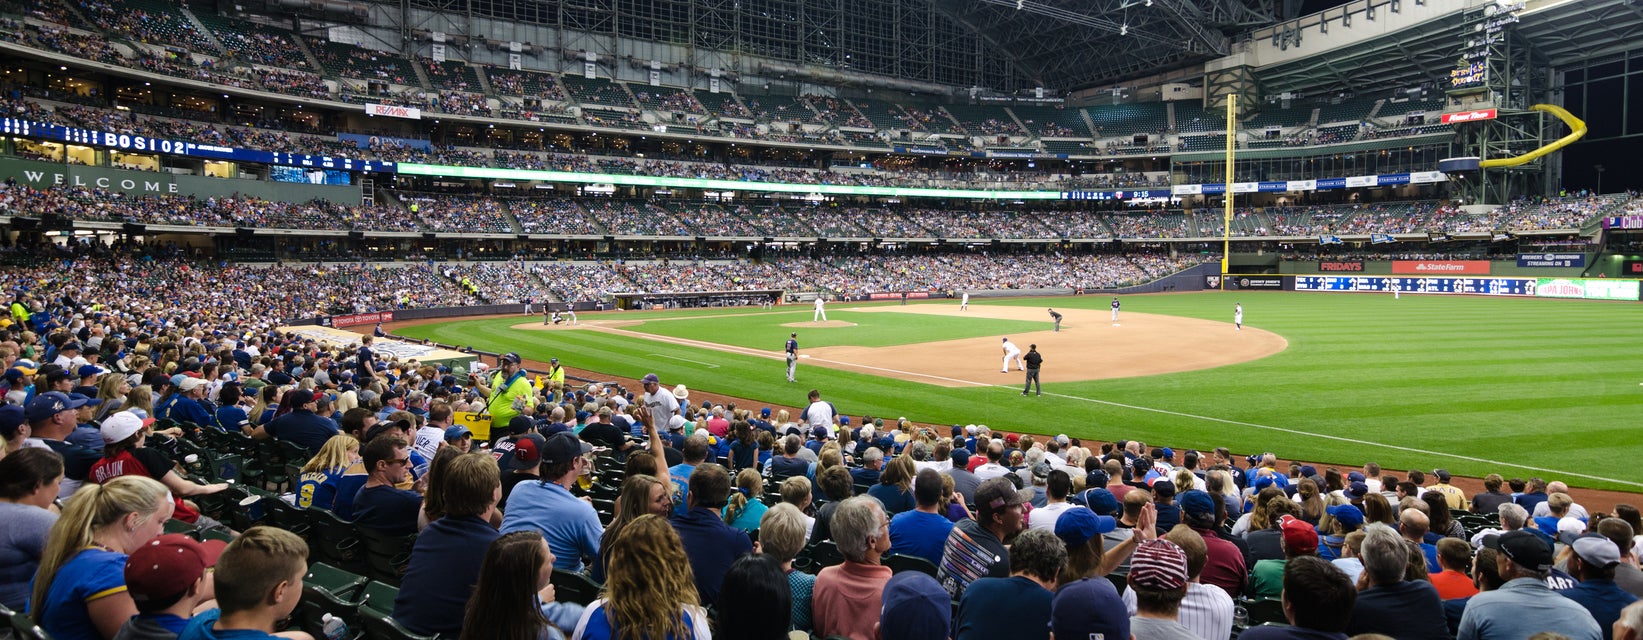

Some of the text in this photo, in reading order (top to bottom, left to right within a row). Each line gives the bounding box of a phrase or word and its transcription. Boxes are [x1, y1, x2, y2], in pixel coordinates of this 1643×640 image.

[376, 105, 408, 117] RE/MAX
[382, 138, 404, 148] PNC
[24, 170, 178, 193] WELCOME
[1623, 216, 1642, 229] Club
[1320, 262, 1361, 271] FRIDAYS
[95, 460, 124, 483] BRAUN
[299, 484, 315, 508] 9
[1546, 576, 1573, 590] ART
